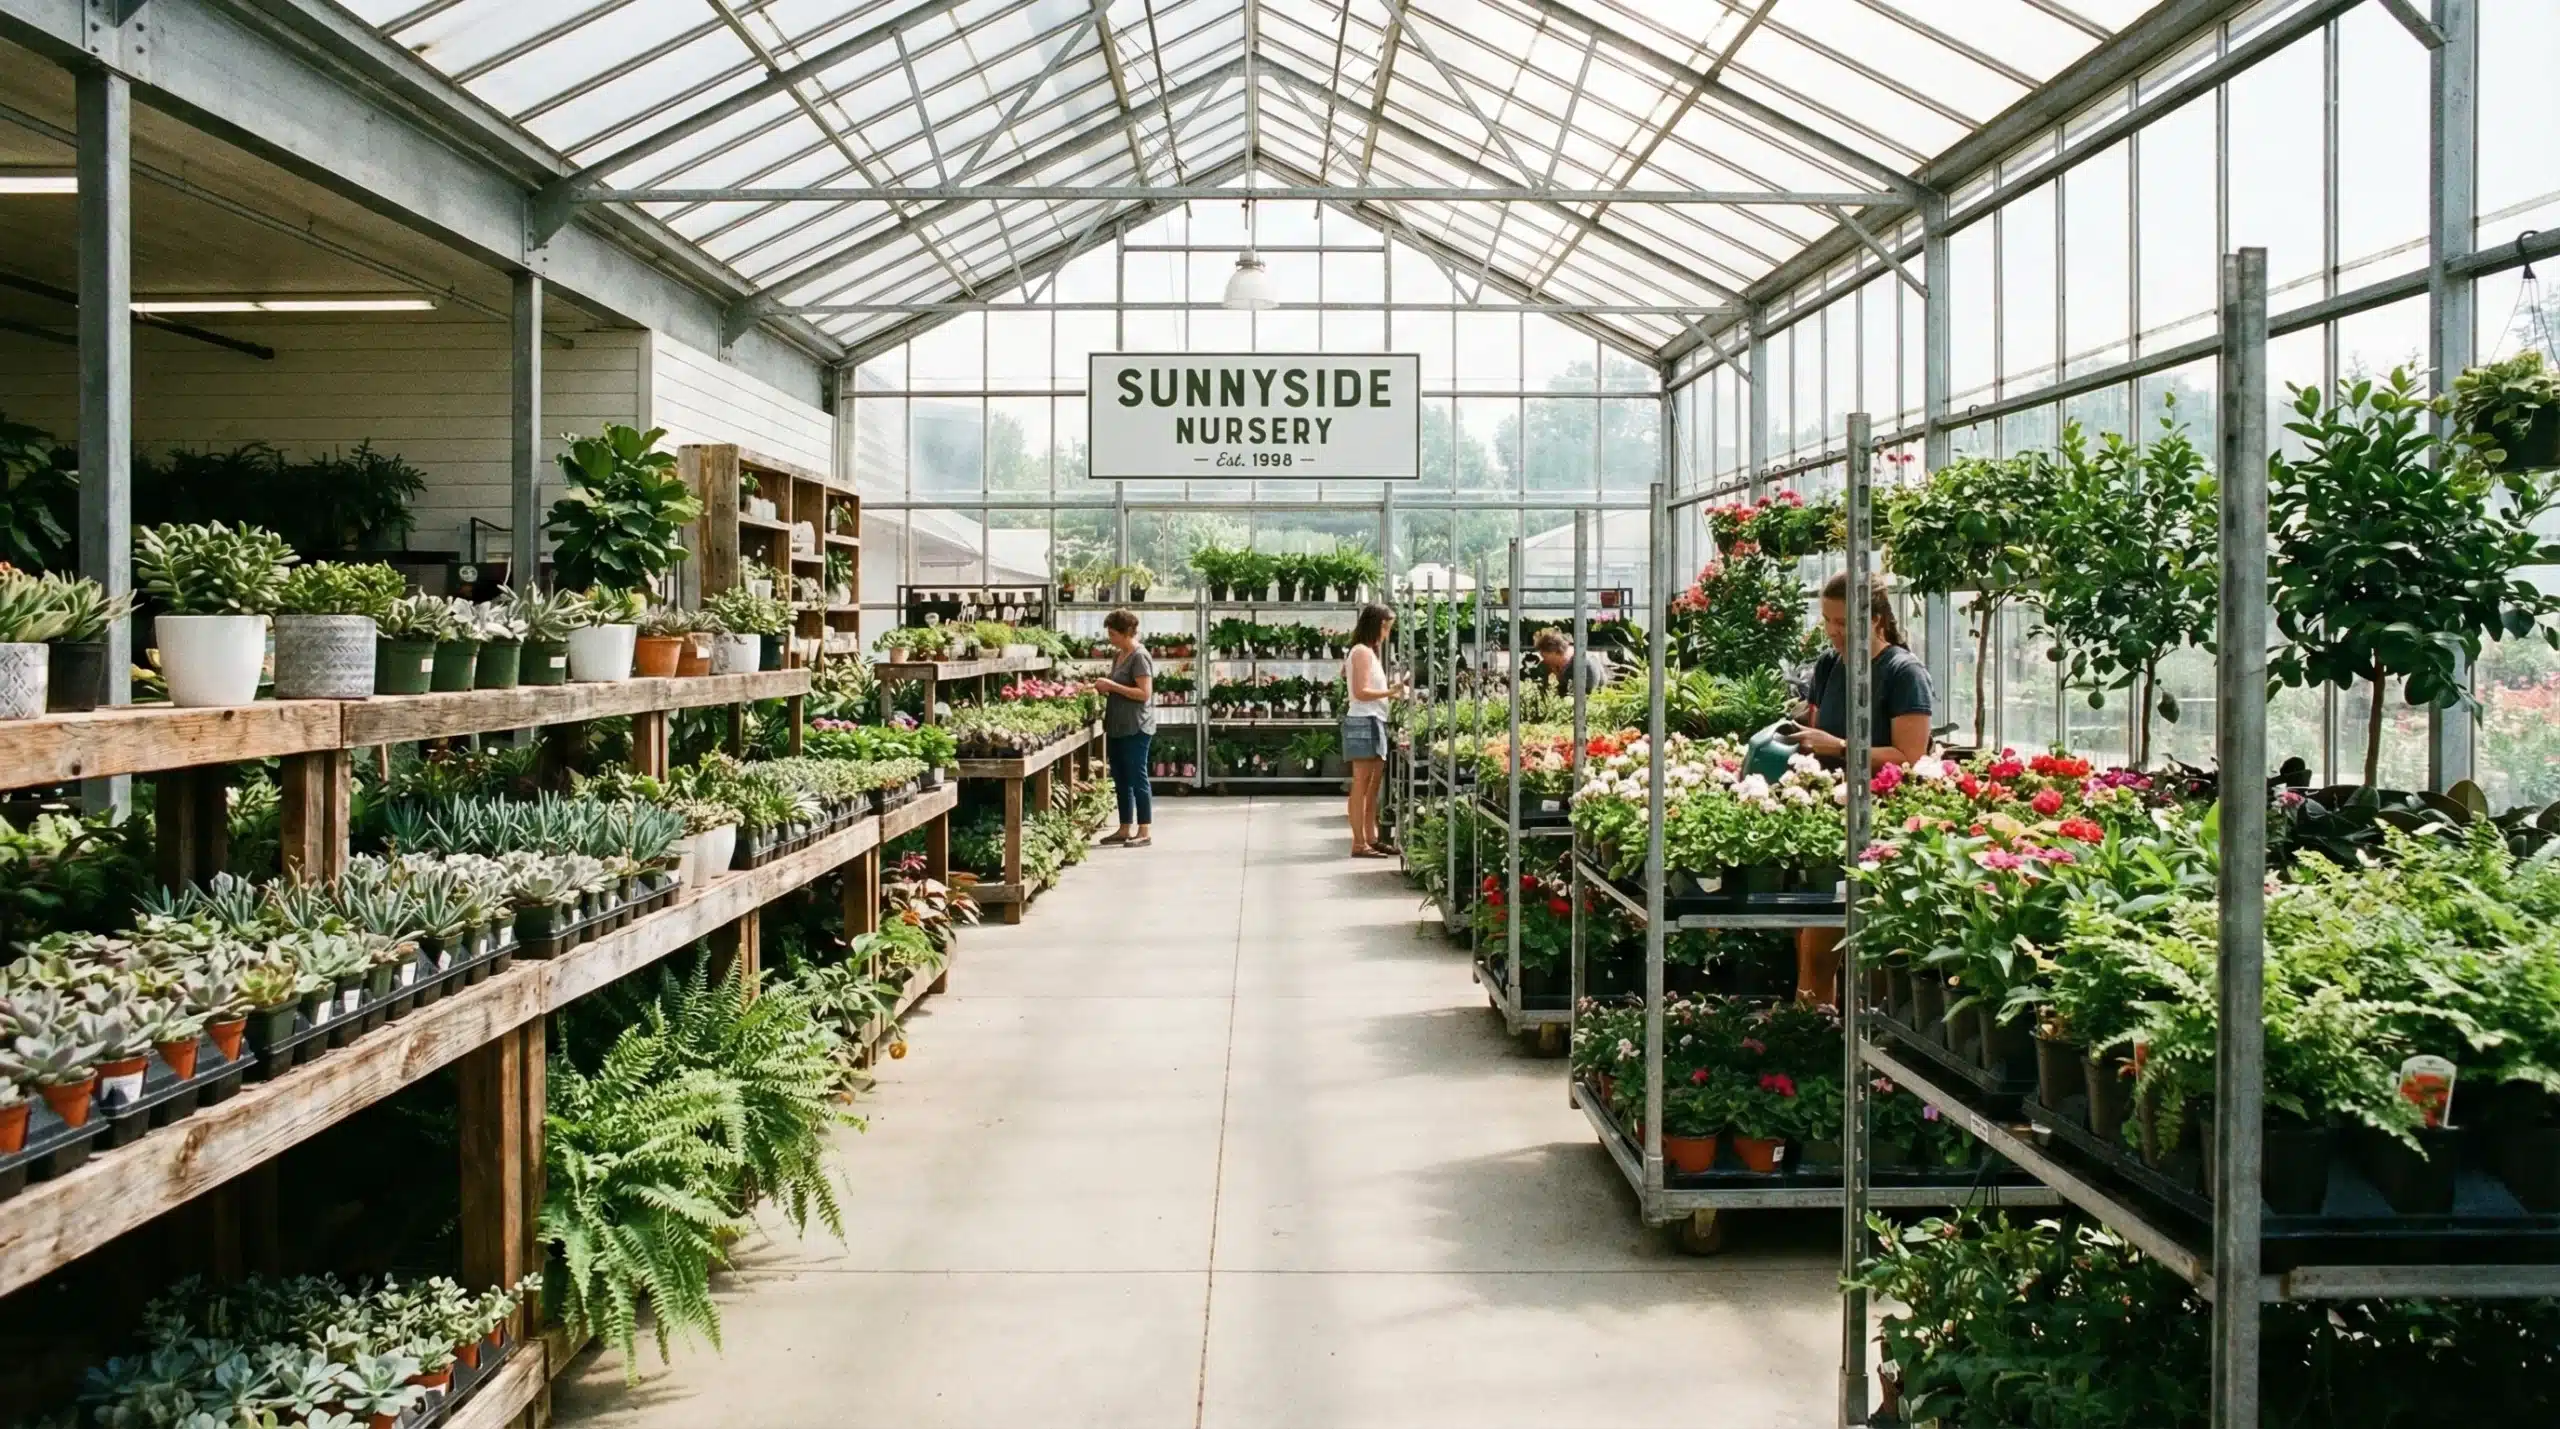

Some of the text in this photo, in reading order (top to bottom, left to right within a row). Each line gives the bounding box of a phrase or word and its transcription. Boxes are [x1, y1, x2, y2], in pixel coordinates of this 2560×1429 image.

[1117, 368, 1391, 408] SUNNYSIDE
[1176, 417, 1333, 444] NURSERY
[1216, 451, 1293, 467] Est. 1998
